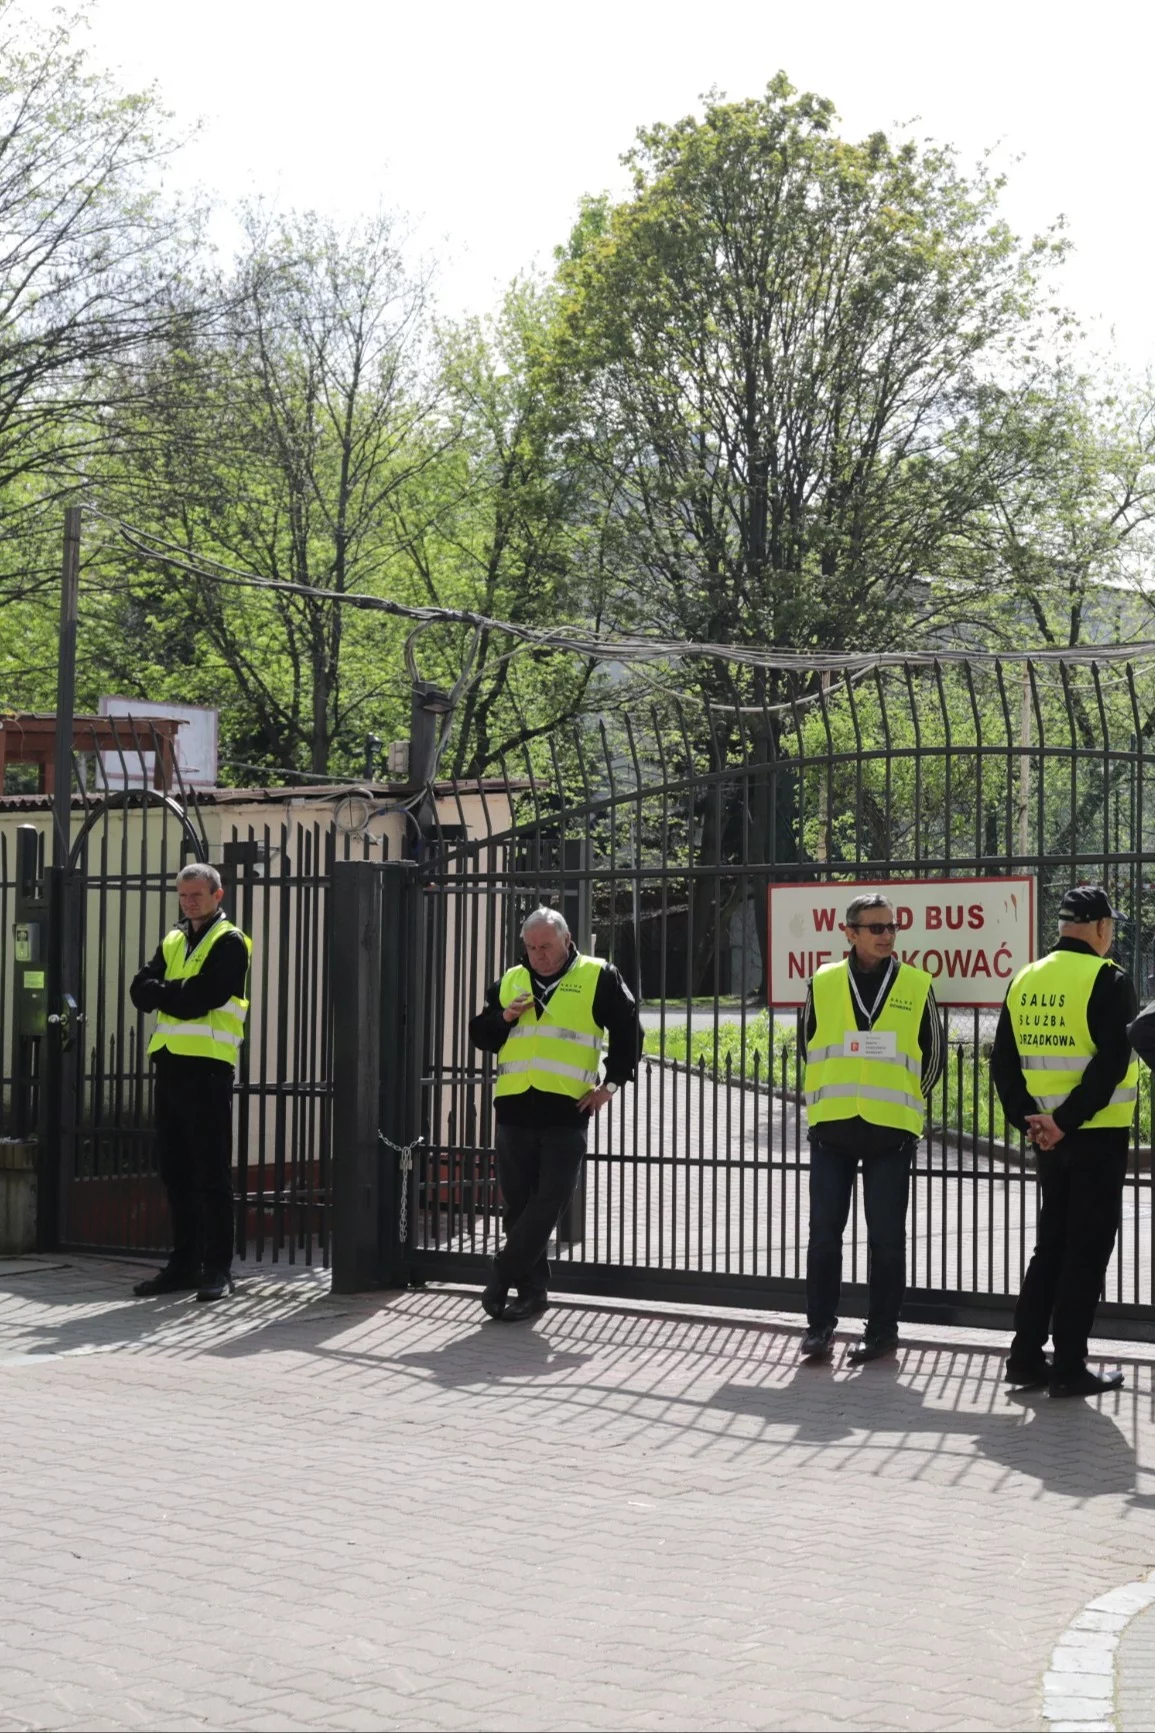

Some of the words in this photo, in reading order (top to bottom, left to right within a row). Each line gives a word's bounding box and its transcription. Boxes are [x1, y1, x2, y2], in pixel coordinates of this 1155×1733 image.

[926, 904, 985, 930] BUS
[843, 941, 1013, 978] KOWAĆ
[1020, 993, 1066, 1007] SALUS
